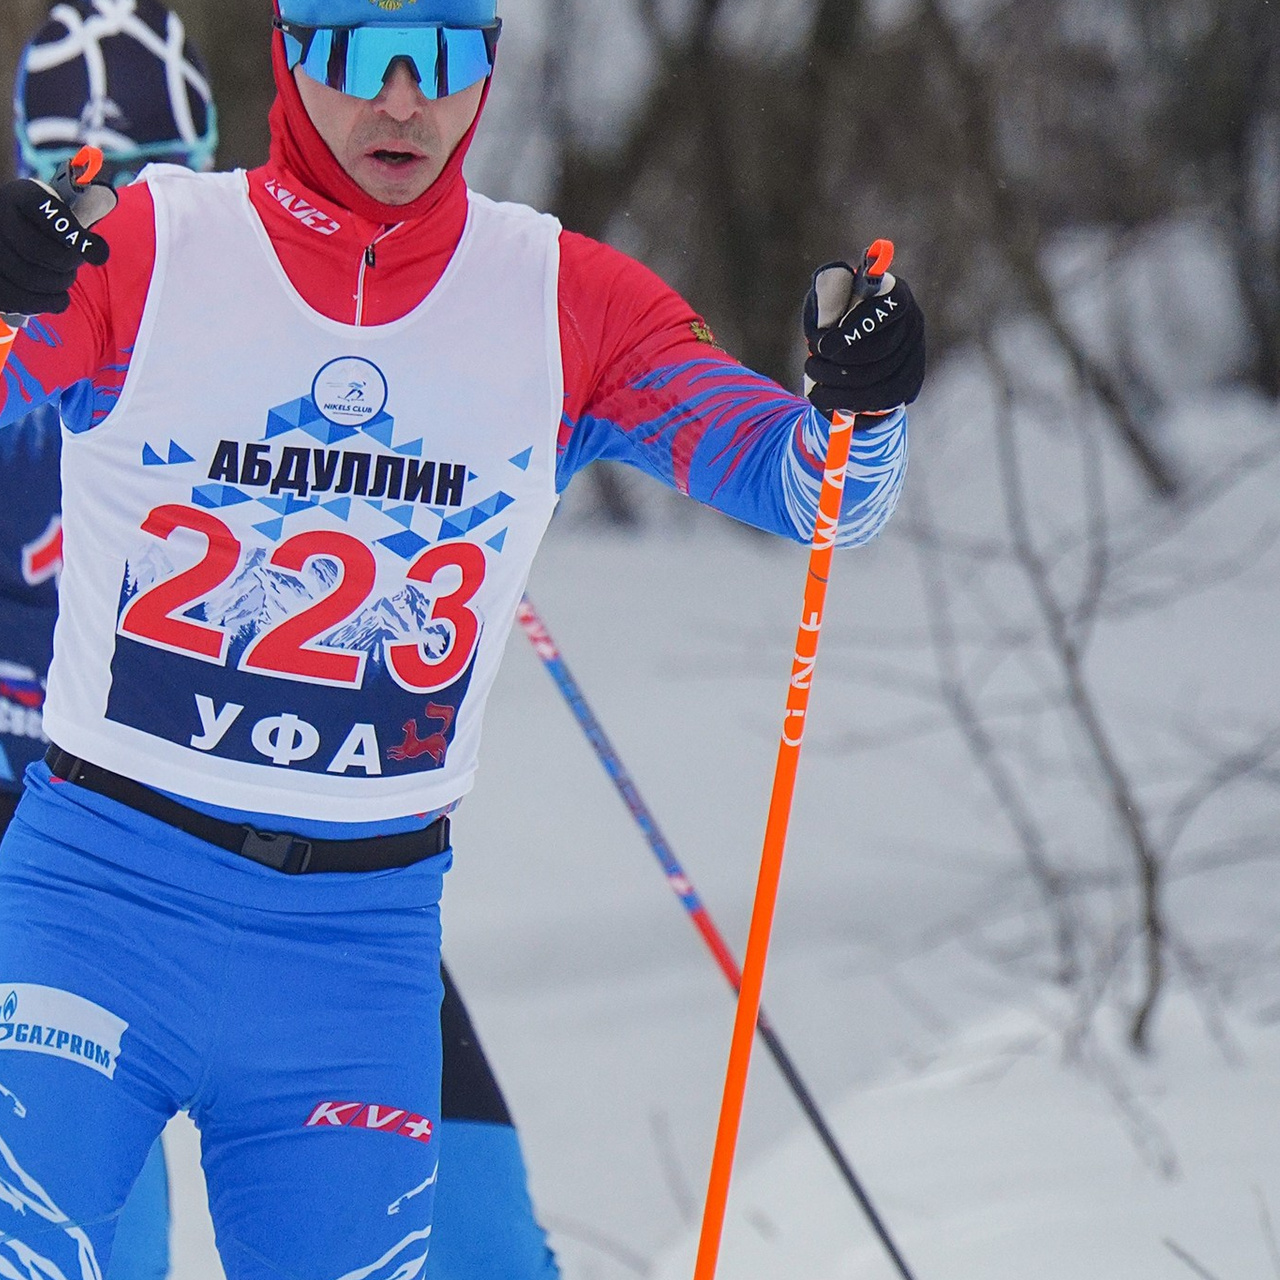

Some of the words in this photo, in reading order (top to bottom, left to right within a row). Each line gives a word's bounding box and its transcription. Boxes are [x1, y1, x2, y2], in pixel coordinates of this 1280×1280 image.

[844, 296, 898, 346] MOAX
[323, 403, 351, 412] NIKELS
[352, 405, 373, 414] CLUB
[207, 439, 467, 507] АБДУЛЛИН
[117, 503, 488, 695] 223
[189, 693, 384, 776] УФА
[14, 1023, 111, 1069] GAZPROM
[305, 1101, 432, 1138] KV+
